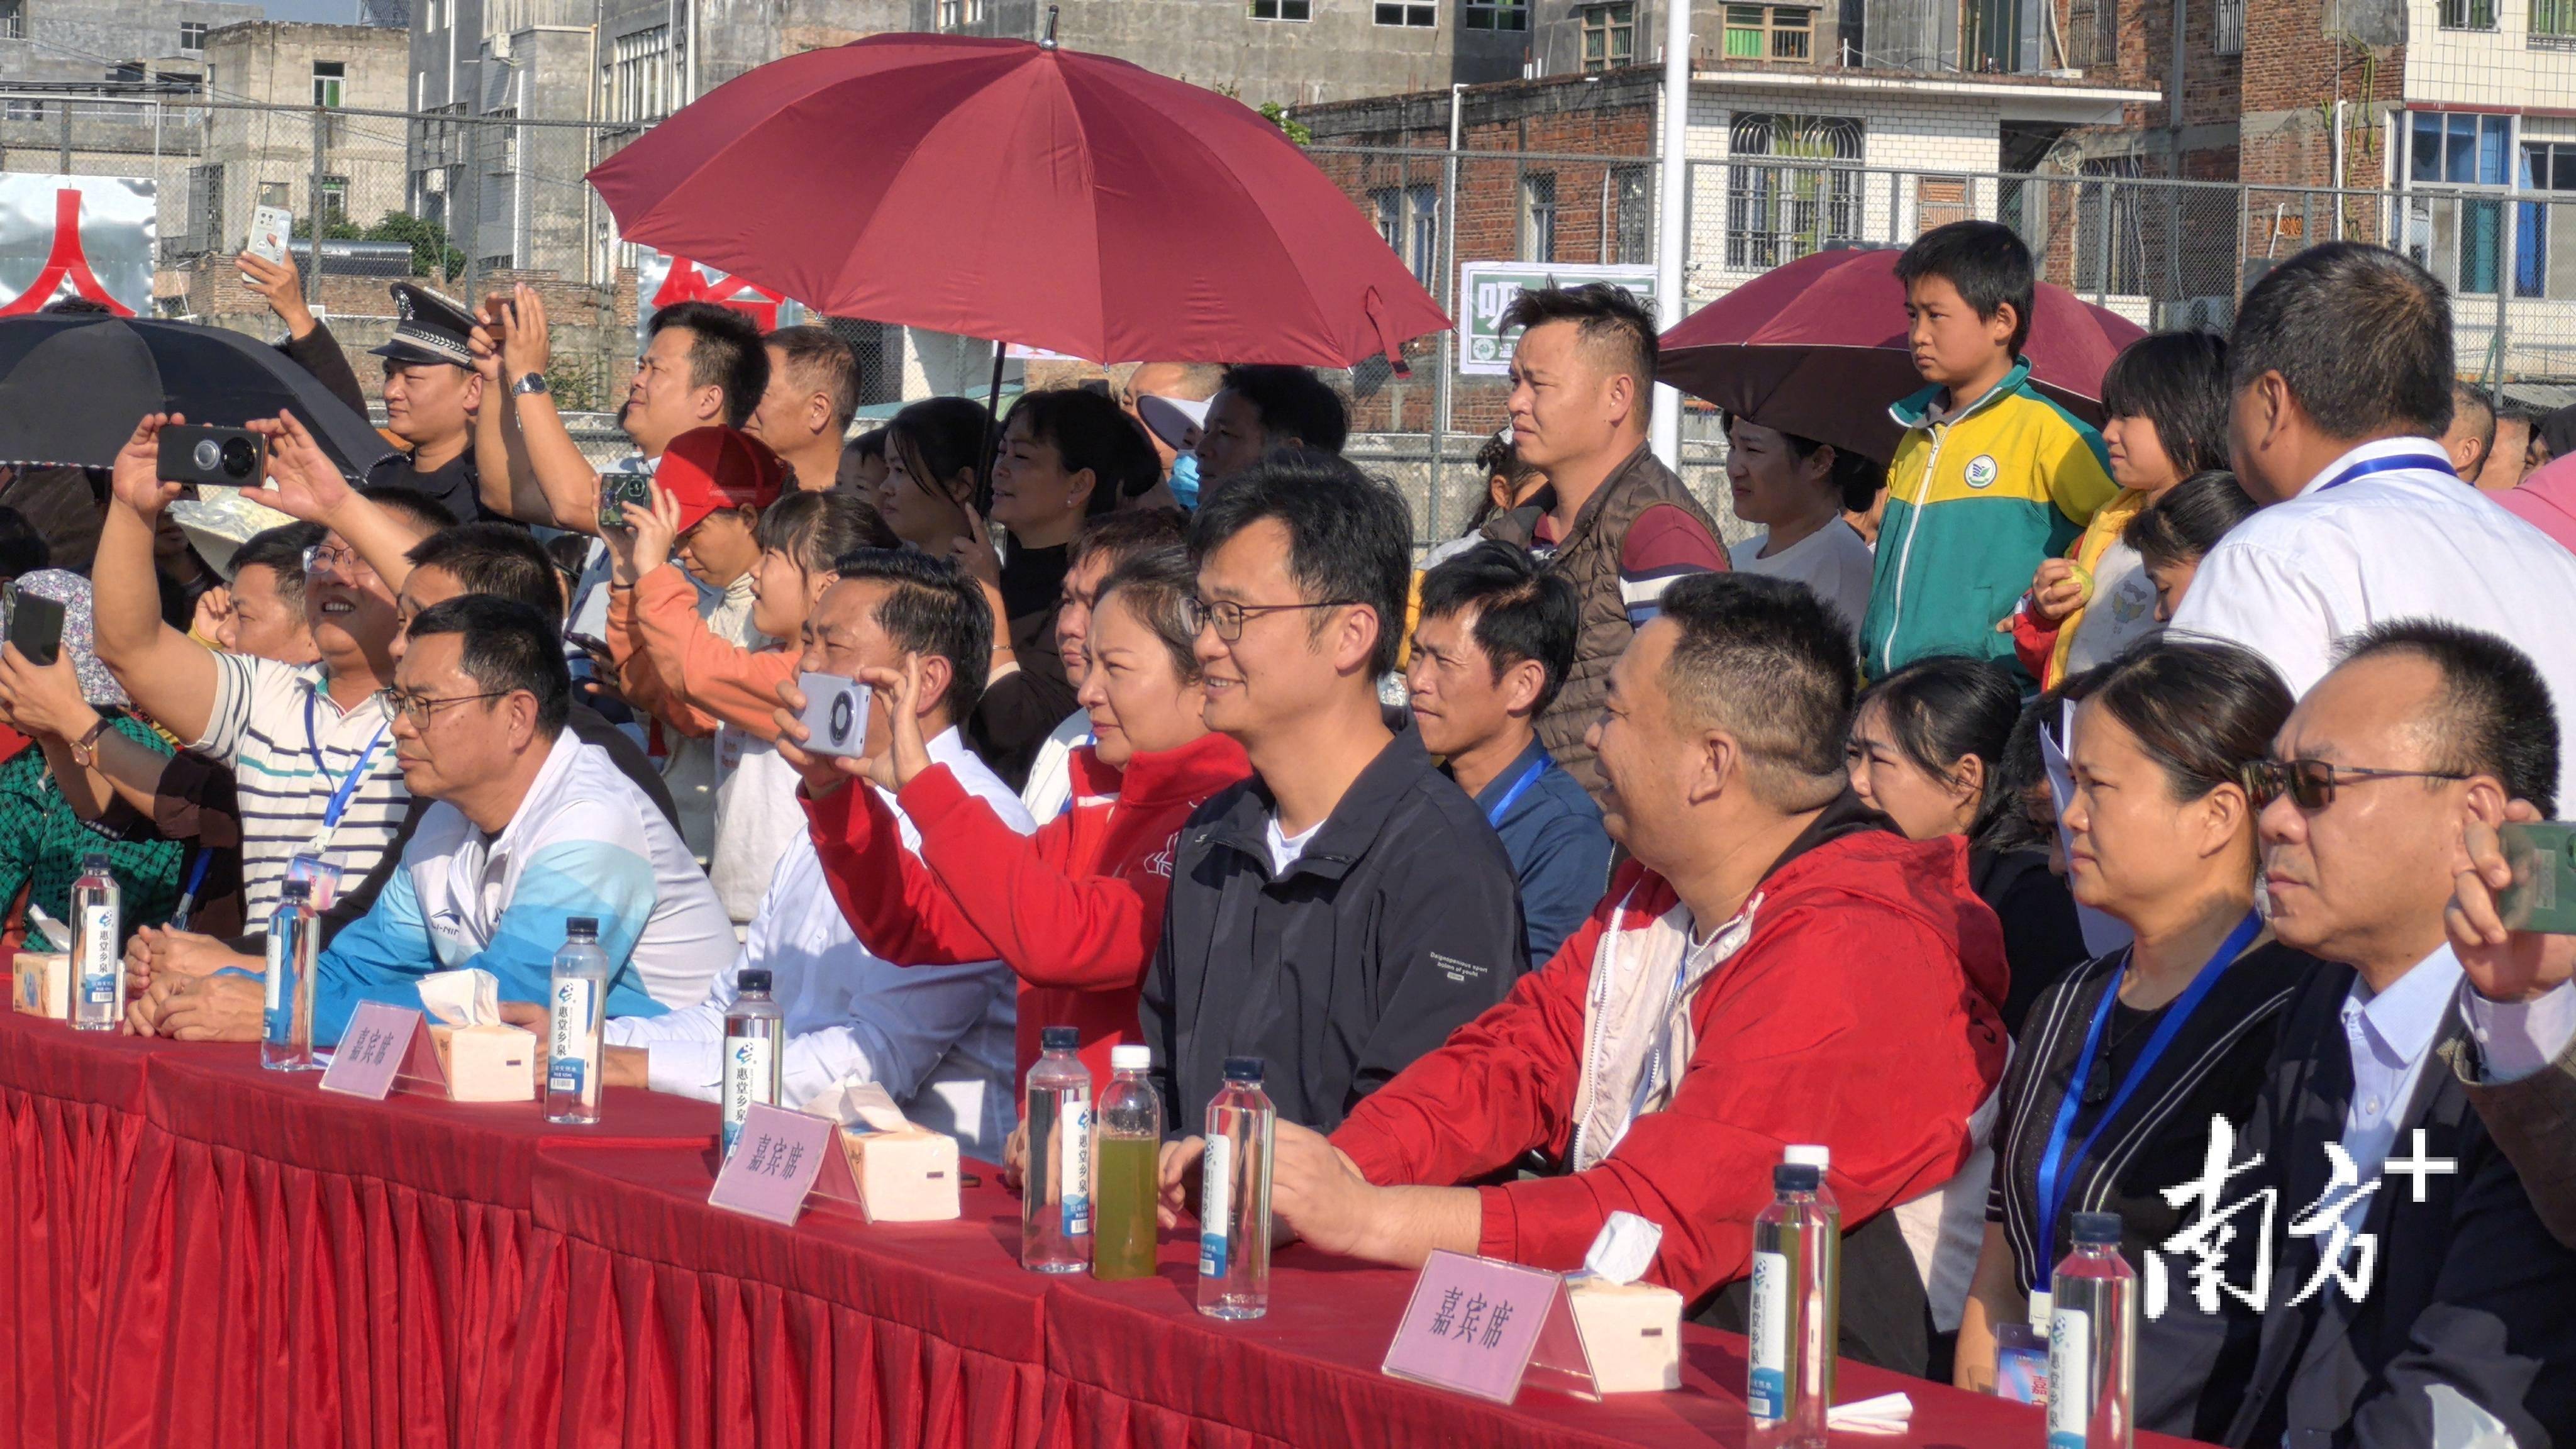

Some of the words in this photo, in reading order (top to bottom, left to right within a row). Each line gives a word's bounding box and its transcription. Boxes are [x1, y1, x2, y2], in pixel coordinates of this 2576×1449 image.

[556, 1006, 569, 1057] 惠堂乡泉
[735, 1067, 748, 1122] 惠堂乡泉
[747, 1133, 804, 1180] 嘉宾席
[1078, 1133, 1087, 1194] 惠堂乡泉
[1428, 1286, 1513, 1350] 嘉宾席
